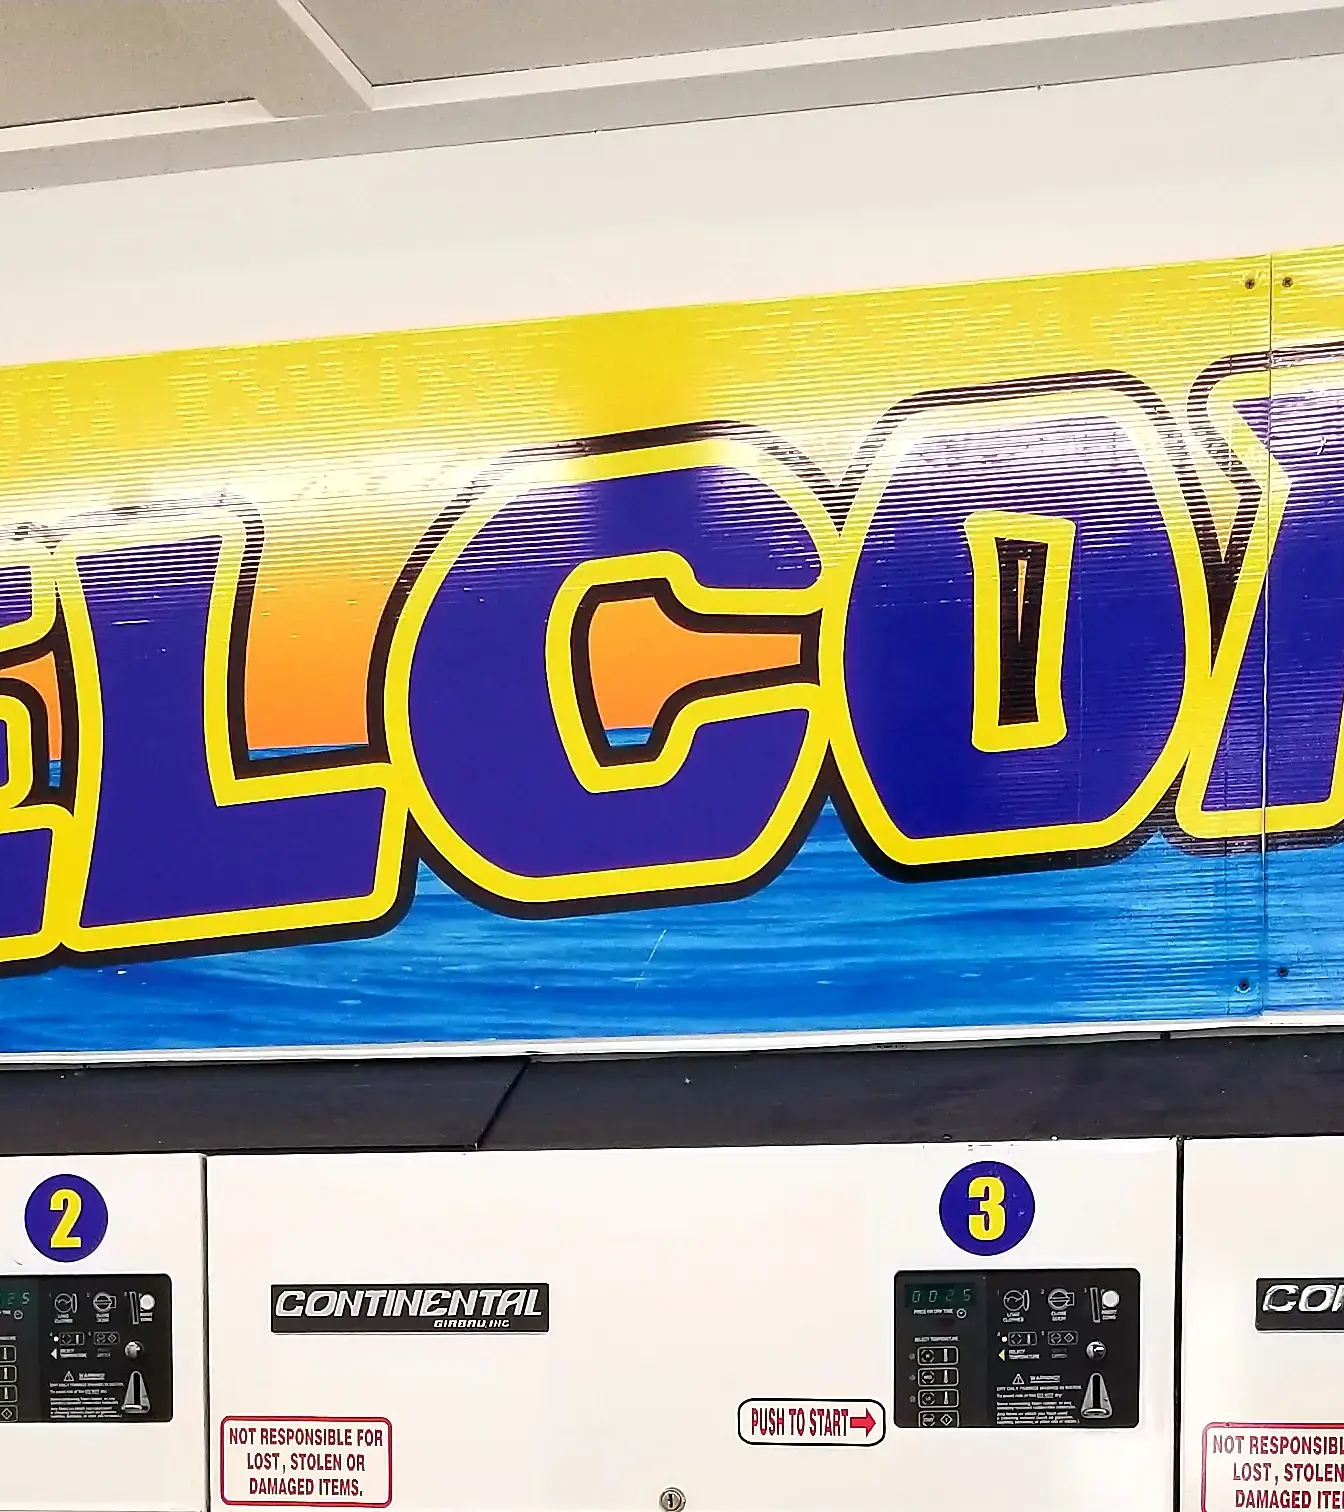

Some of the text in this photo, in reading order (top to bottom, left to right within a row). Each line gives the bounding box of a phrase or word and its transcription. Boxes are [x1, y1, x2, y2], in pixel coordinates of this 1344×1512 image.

[50, 1189, 82, 1248] 2
[968, 1176, 1005, 1241] 3
[275, 1289, 543, 1317] CONTINENTAL
[751, 1407, 849, 1437] PUSH TO START
[229, 1428, 384, 1447] NOT RESPONSIBLE FOR
[1212, 1435, 1243, 1456] NOT
[291, 1453, 342, 1472] STOLEN
[345, 1453, 366, 1472] OR
[1284, 1462, 1344, 1483] STOLEN
[249, 1478, 363, 1498] DAMAGED ITEMS.
[1235, 1489, 1313, 1510] DAMAGED
